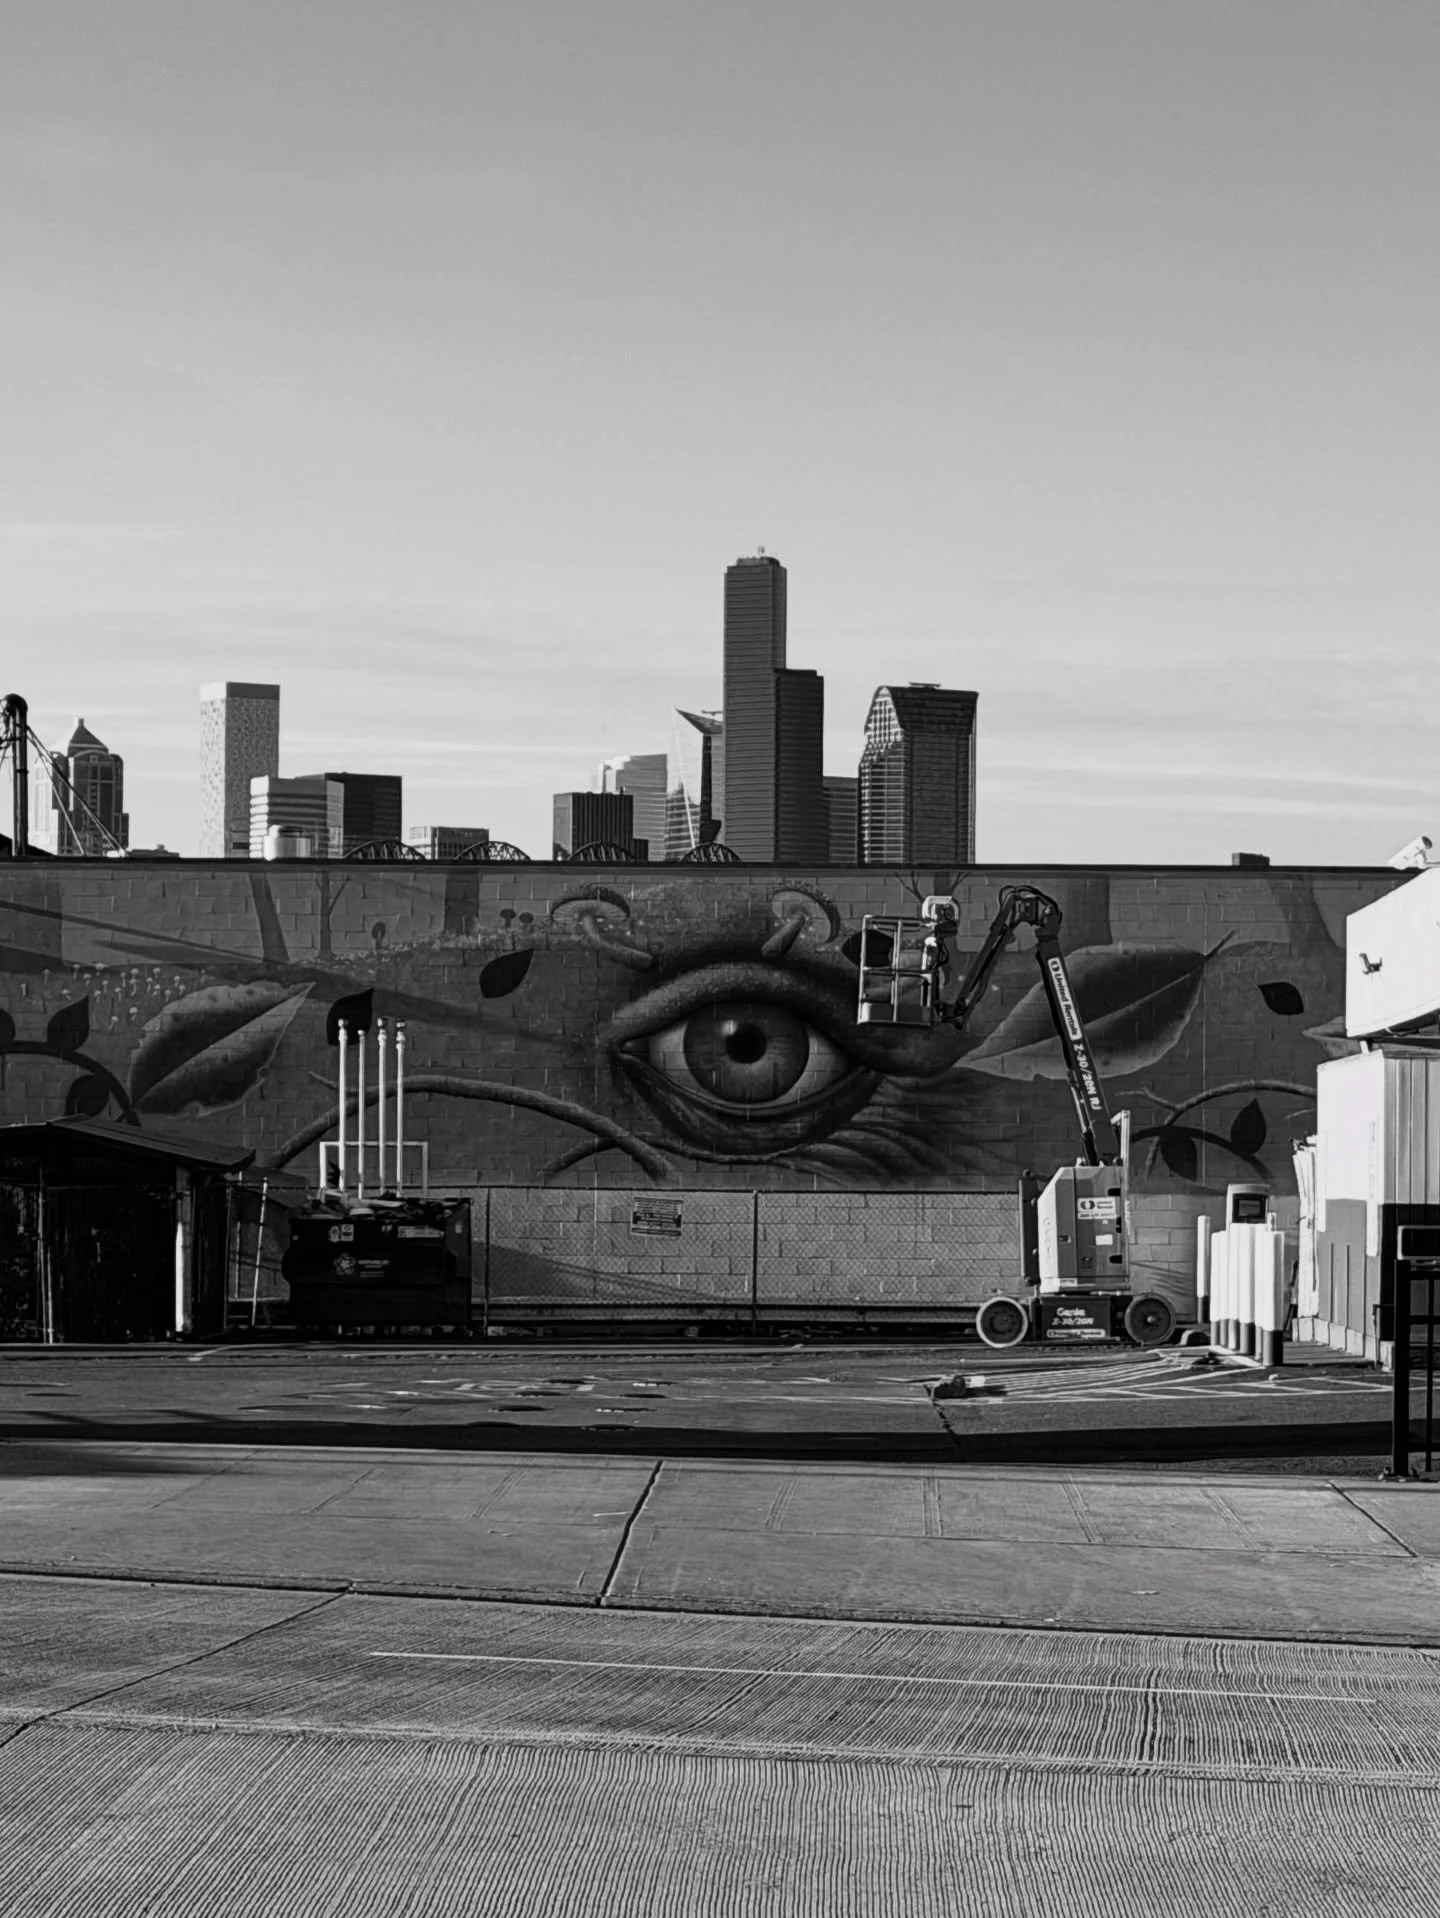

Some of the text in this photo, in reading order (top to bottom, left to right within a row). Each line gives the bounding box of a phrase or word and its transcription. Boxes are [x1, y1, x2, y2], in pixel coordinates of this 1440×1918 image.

[1054, 973, 1078, 1035] United Rentals
[1073, 1044, 1096, 1094] Z-30/20N
